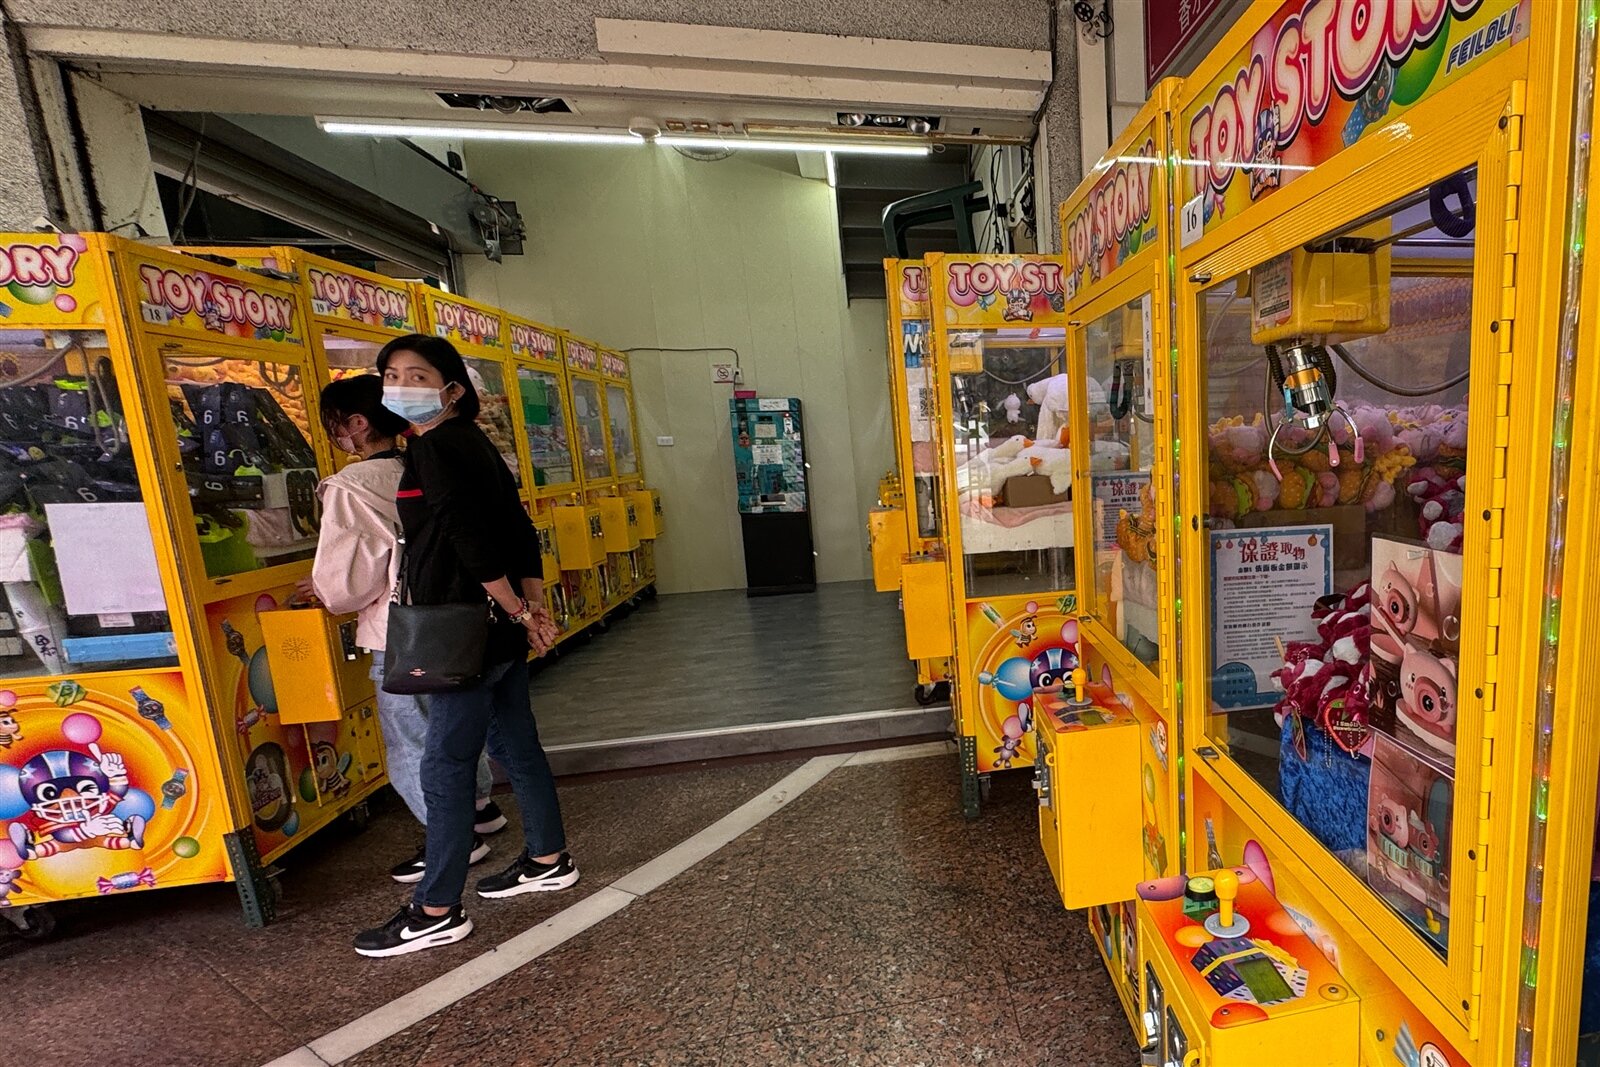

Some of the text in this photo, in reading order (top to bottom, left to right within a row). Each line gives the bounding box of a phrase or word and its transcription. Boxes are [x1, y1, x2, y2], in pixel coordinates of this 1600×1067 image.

[1179, 0, 1202, 34] 香
[1445, 3, 1519, 77] FEILOLI
[1188, 0, 1484, 196] TOY STO
[1067, 138, 1154, 274] TOY STORY
[1185, 207, 1198, 234] 16
[0, 243, 78, 288] RY
[949, 262, 1015, 296] TOY
[1021, 262, 1065, 296] ST
[140, 263, 294, 334] TOY STORY
[309, 268, 409, 322] TOY STORY
[316, 303, 325, 312] 19
[149, 308, 161, 321] 18
[434, 300, 500, 338] TOY STORY
[510, 323, 556, 353] TOY STORY
[1239, 541, 1305, 563] 保證取物
